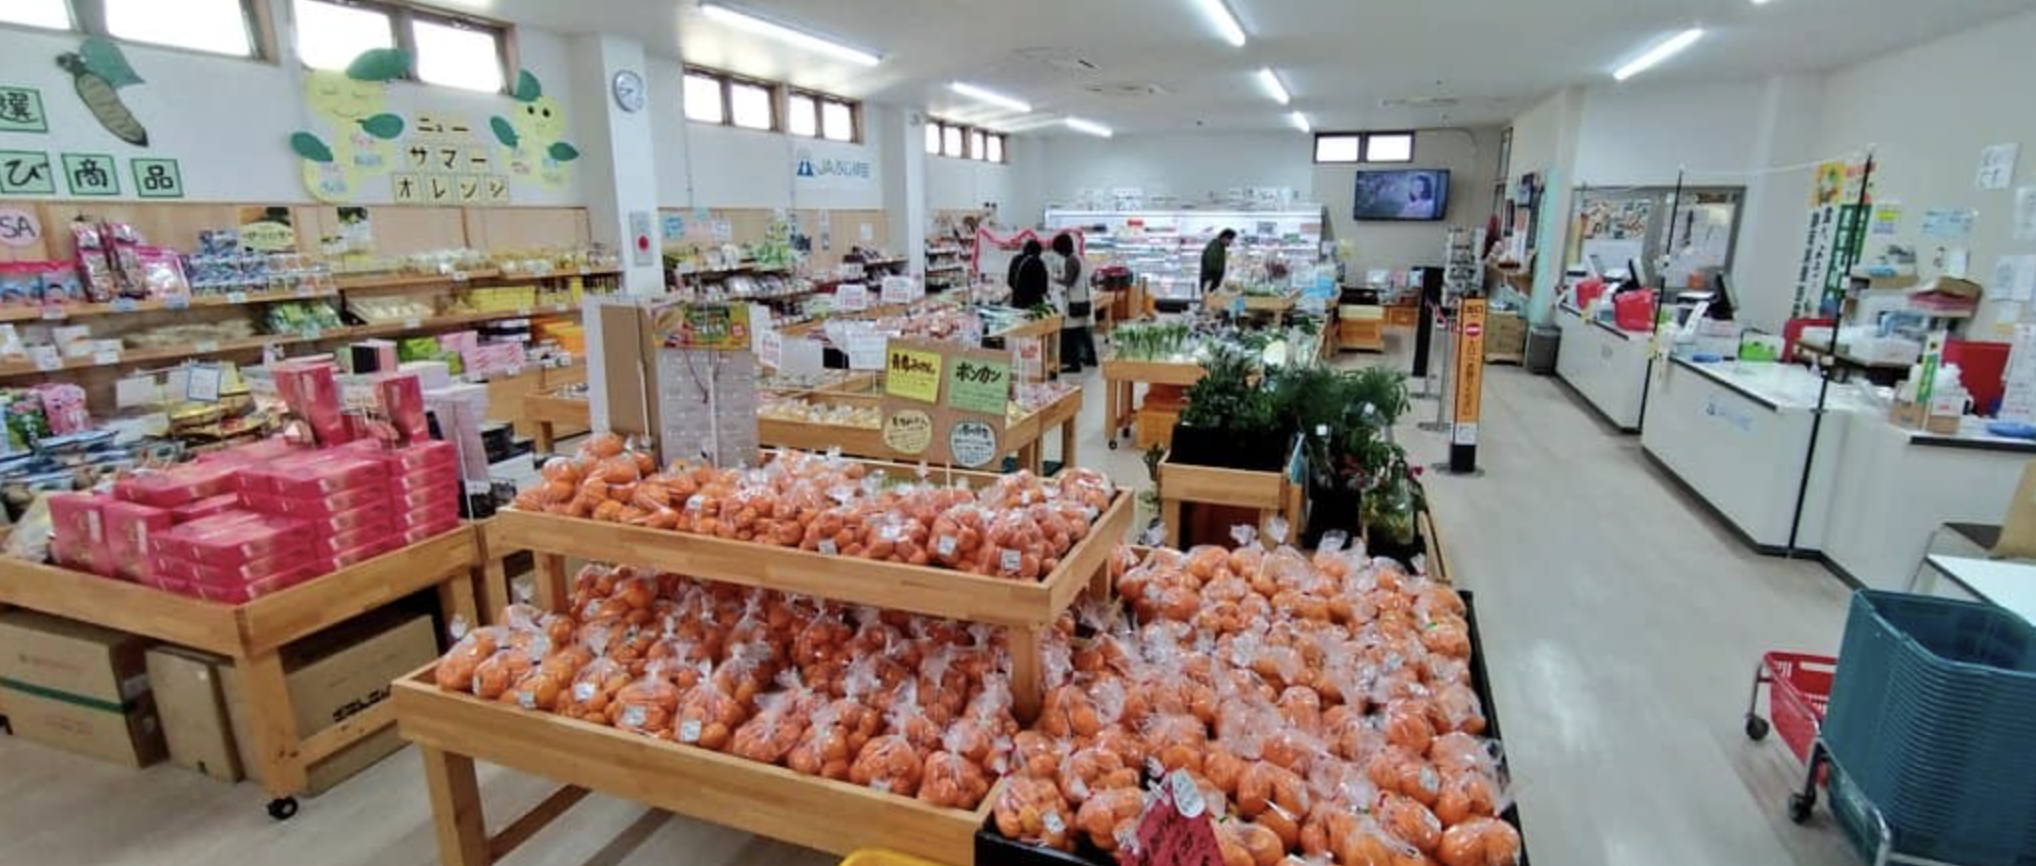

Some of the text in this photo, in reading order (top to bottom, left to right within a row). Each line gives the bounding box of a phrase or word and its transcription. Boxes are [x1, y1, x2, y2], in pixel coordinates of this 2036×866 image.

[418, 118, 469, 133] ニュー
[410, 147, 487, 169] サマー
[3, 158, 174, 190] び商品
[956, 362, 1001, 384] ポンカン
